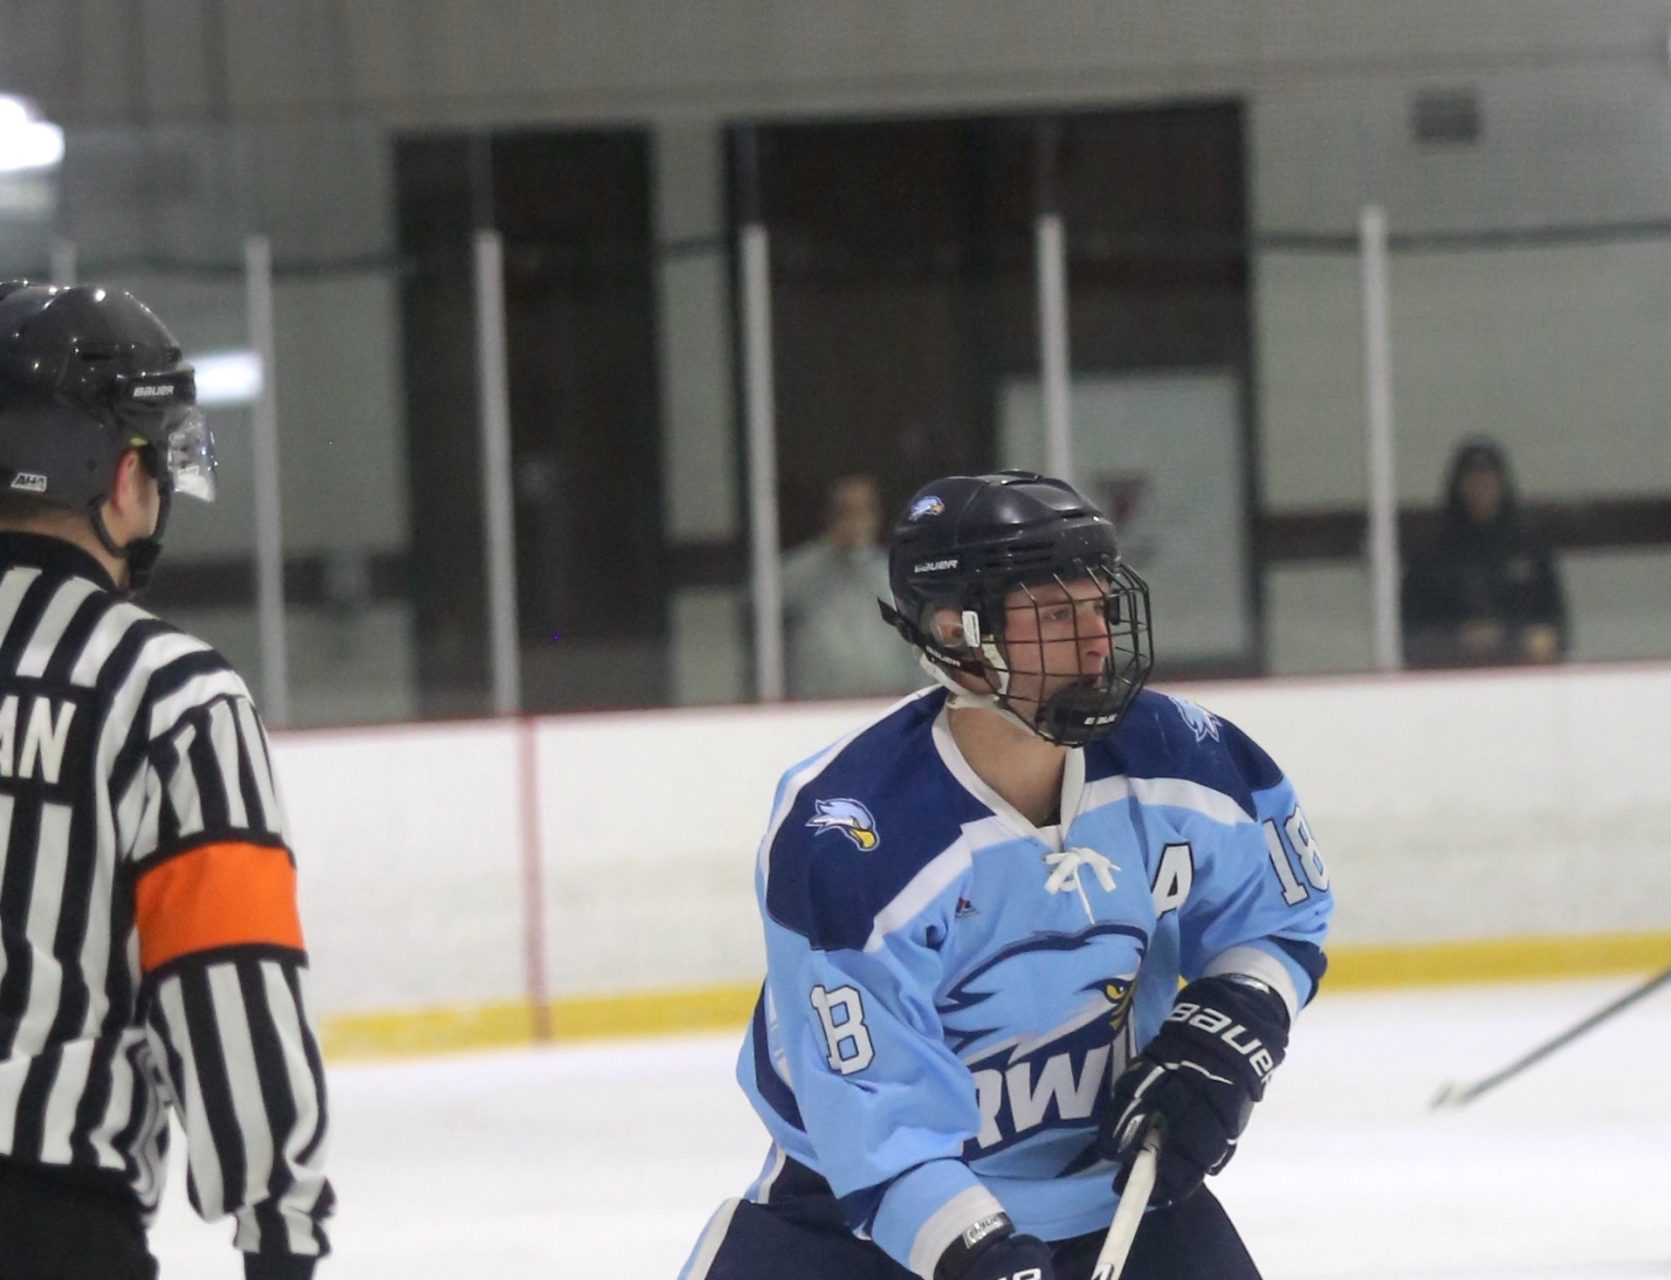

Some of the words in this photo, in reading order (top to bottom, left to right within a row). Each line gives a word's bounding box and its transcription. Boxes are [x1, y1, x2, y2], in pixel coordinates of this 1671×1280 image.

[133, 385, 175, 398] BAUER
[1151, 840, 1195, 921] A
[1167, 1002, 1274, 1084] BAUE
